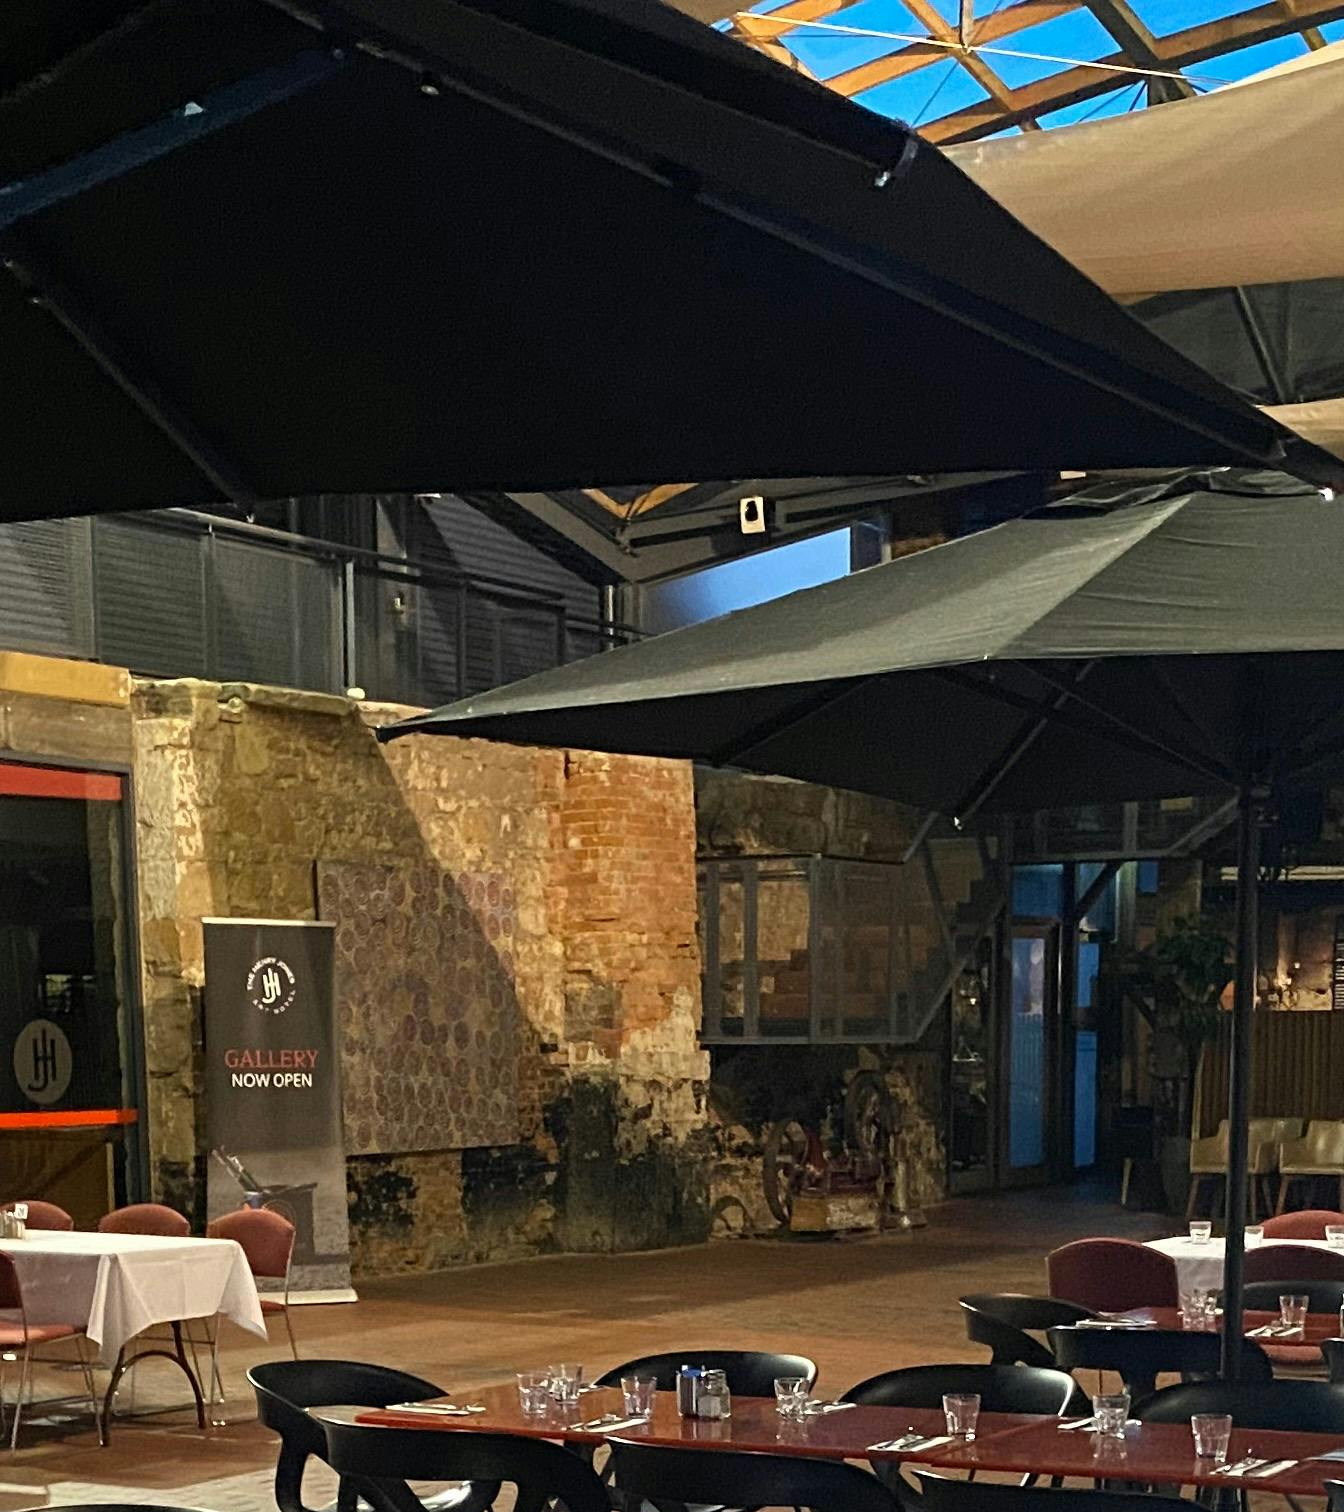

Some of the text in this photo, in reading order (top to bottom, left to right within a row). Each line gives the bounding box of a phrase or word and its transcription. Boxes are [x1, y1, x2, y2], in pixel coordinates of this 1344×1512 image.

[224, 1049, 319, 1069] GALLERY
[231, 1073, 312, 1088] NOW OPEN
